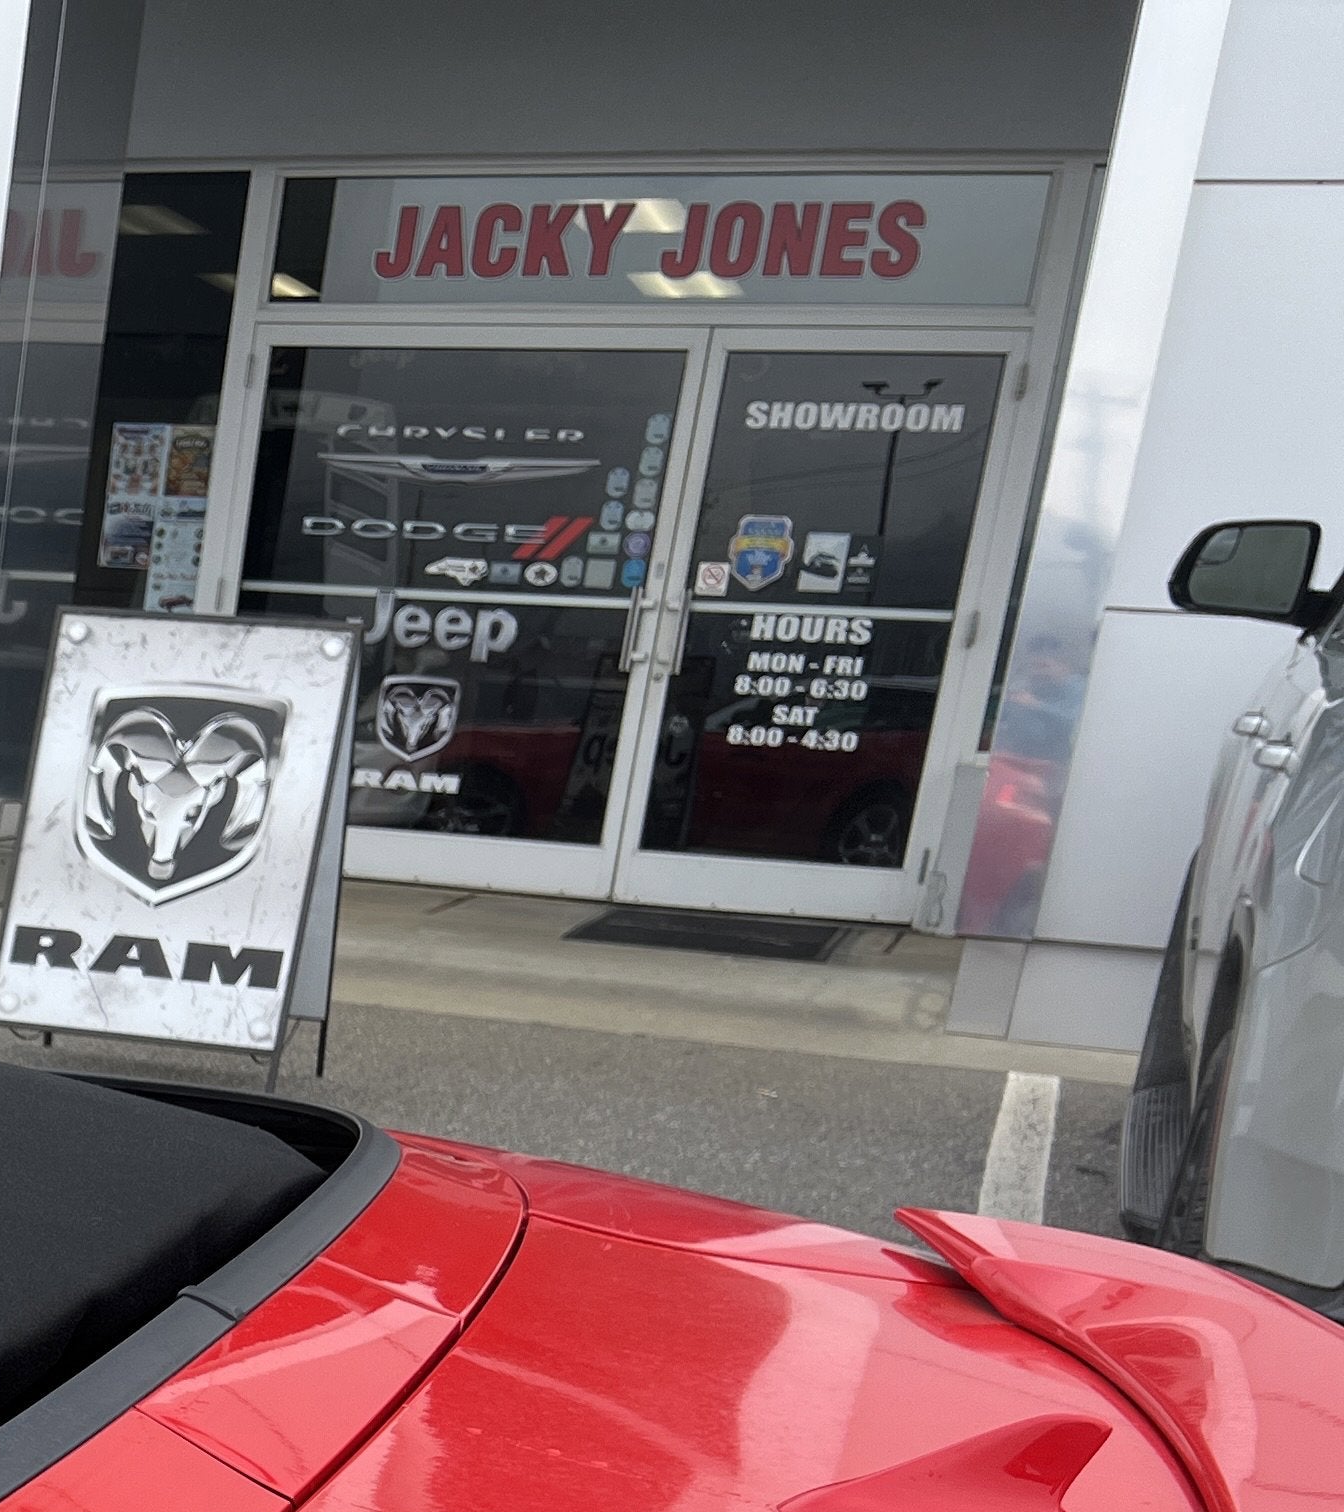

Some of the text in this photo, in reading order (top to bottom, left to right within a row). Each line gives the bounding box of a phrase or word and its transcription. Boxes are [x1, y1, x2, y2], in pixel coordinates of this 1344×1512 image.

[373, 200, 928, 280] JACKY JONES
[745, 400, 966, 432] SHOWROOM
[336, 423, 585, 443] CHRYSLER
[302, 516, 548, 544] DODGE
[363, 588, 519, 663] Jeep
[749, 614, 874, 646] HOURS
[746, 651, 806, 675] MON
[822, 654, 865, 677] FRI
[733, 674, 792, 698] 8:00
[809, 677, 869, 701] 6:30
[771, 703, 820, 726] SAT
[725, 723, 785, 748] 8:00
[800, 728, 860, 752] 4:30
[351, 768, 462, 795] RAM
[8, 925, 284, 990] RAM
